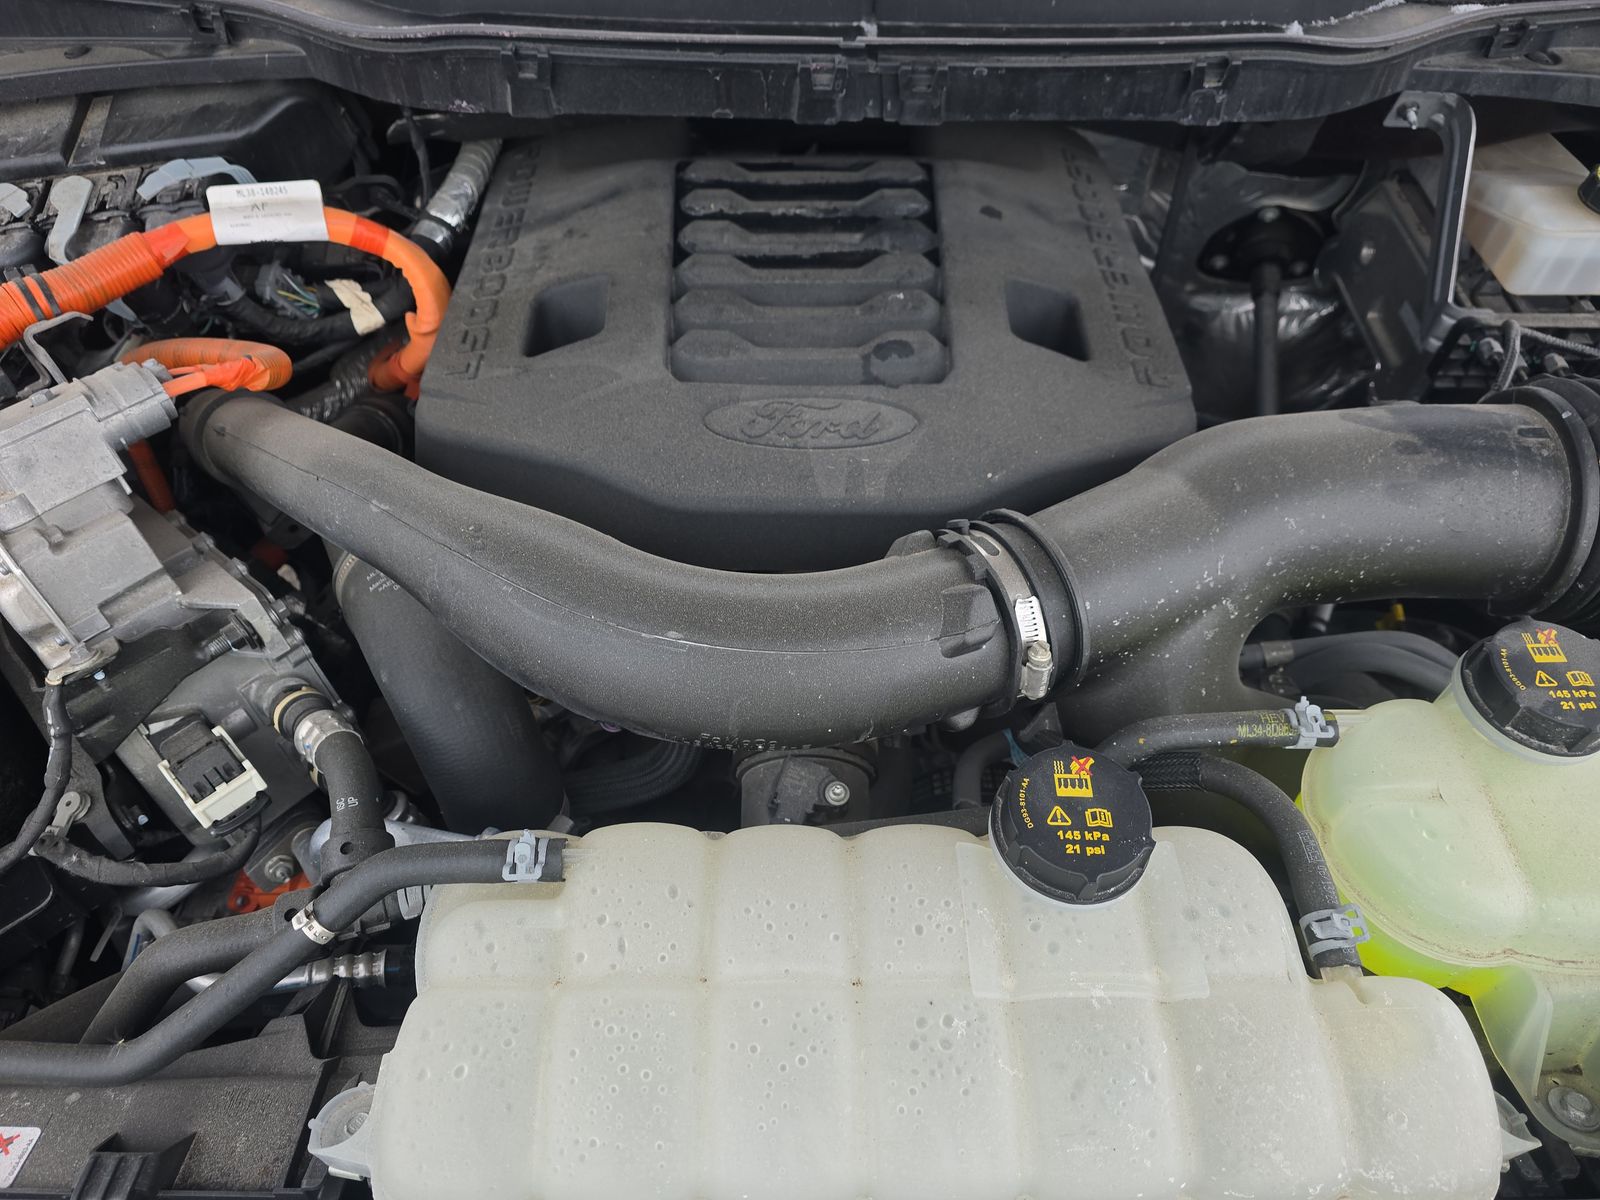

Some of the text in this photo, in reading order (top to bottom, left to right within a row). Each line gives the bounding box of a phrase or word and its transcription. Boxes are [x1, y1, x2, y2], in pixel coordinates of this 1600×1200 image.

[740, 401, 882, 440] Ford
[1548, 689, 1597, 699] 145 kPa
[1560, 700, 1598, 711] 21 psi
[1018, 777, 1035, 830] DG93-8101-AA
[1056, 830, 1111, 842] 145 kPa
[1065, 843, 1106, 857] 21 psi
